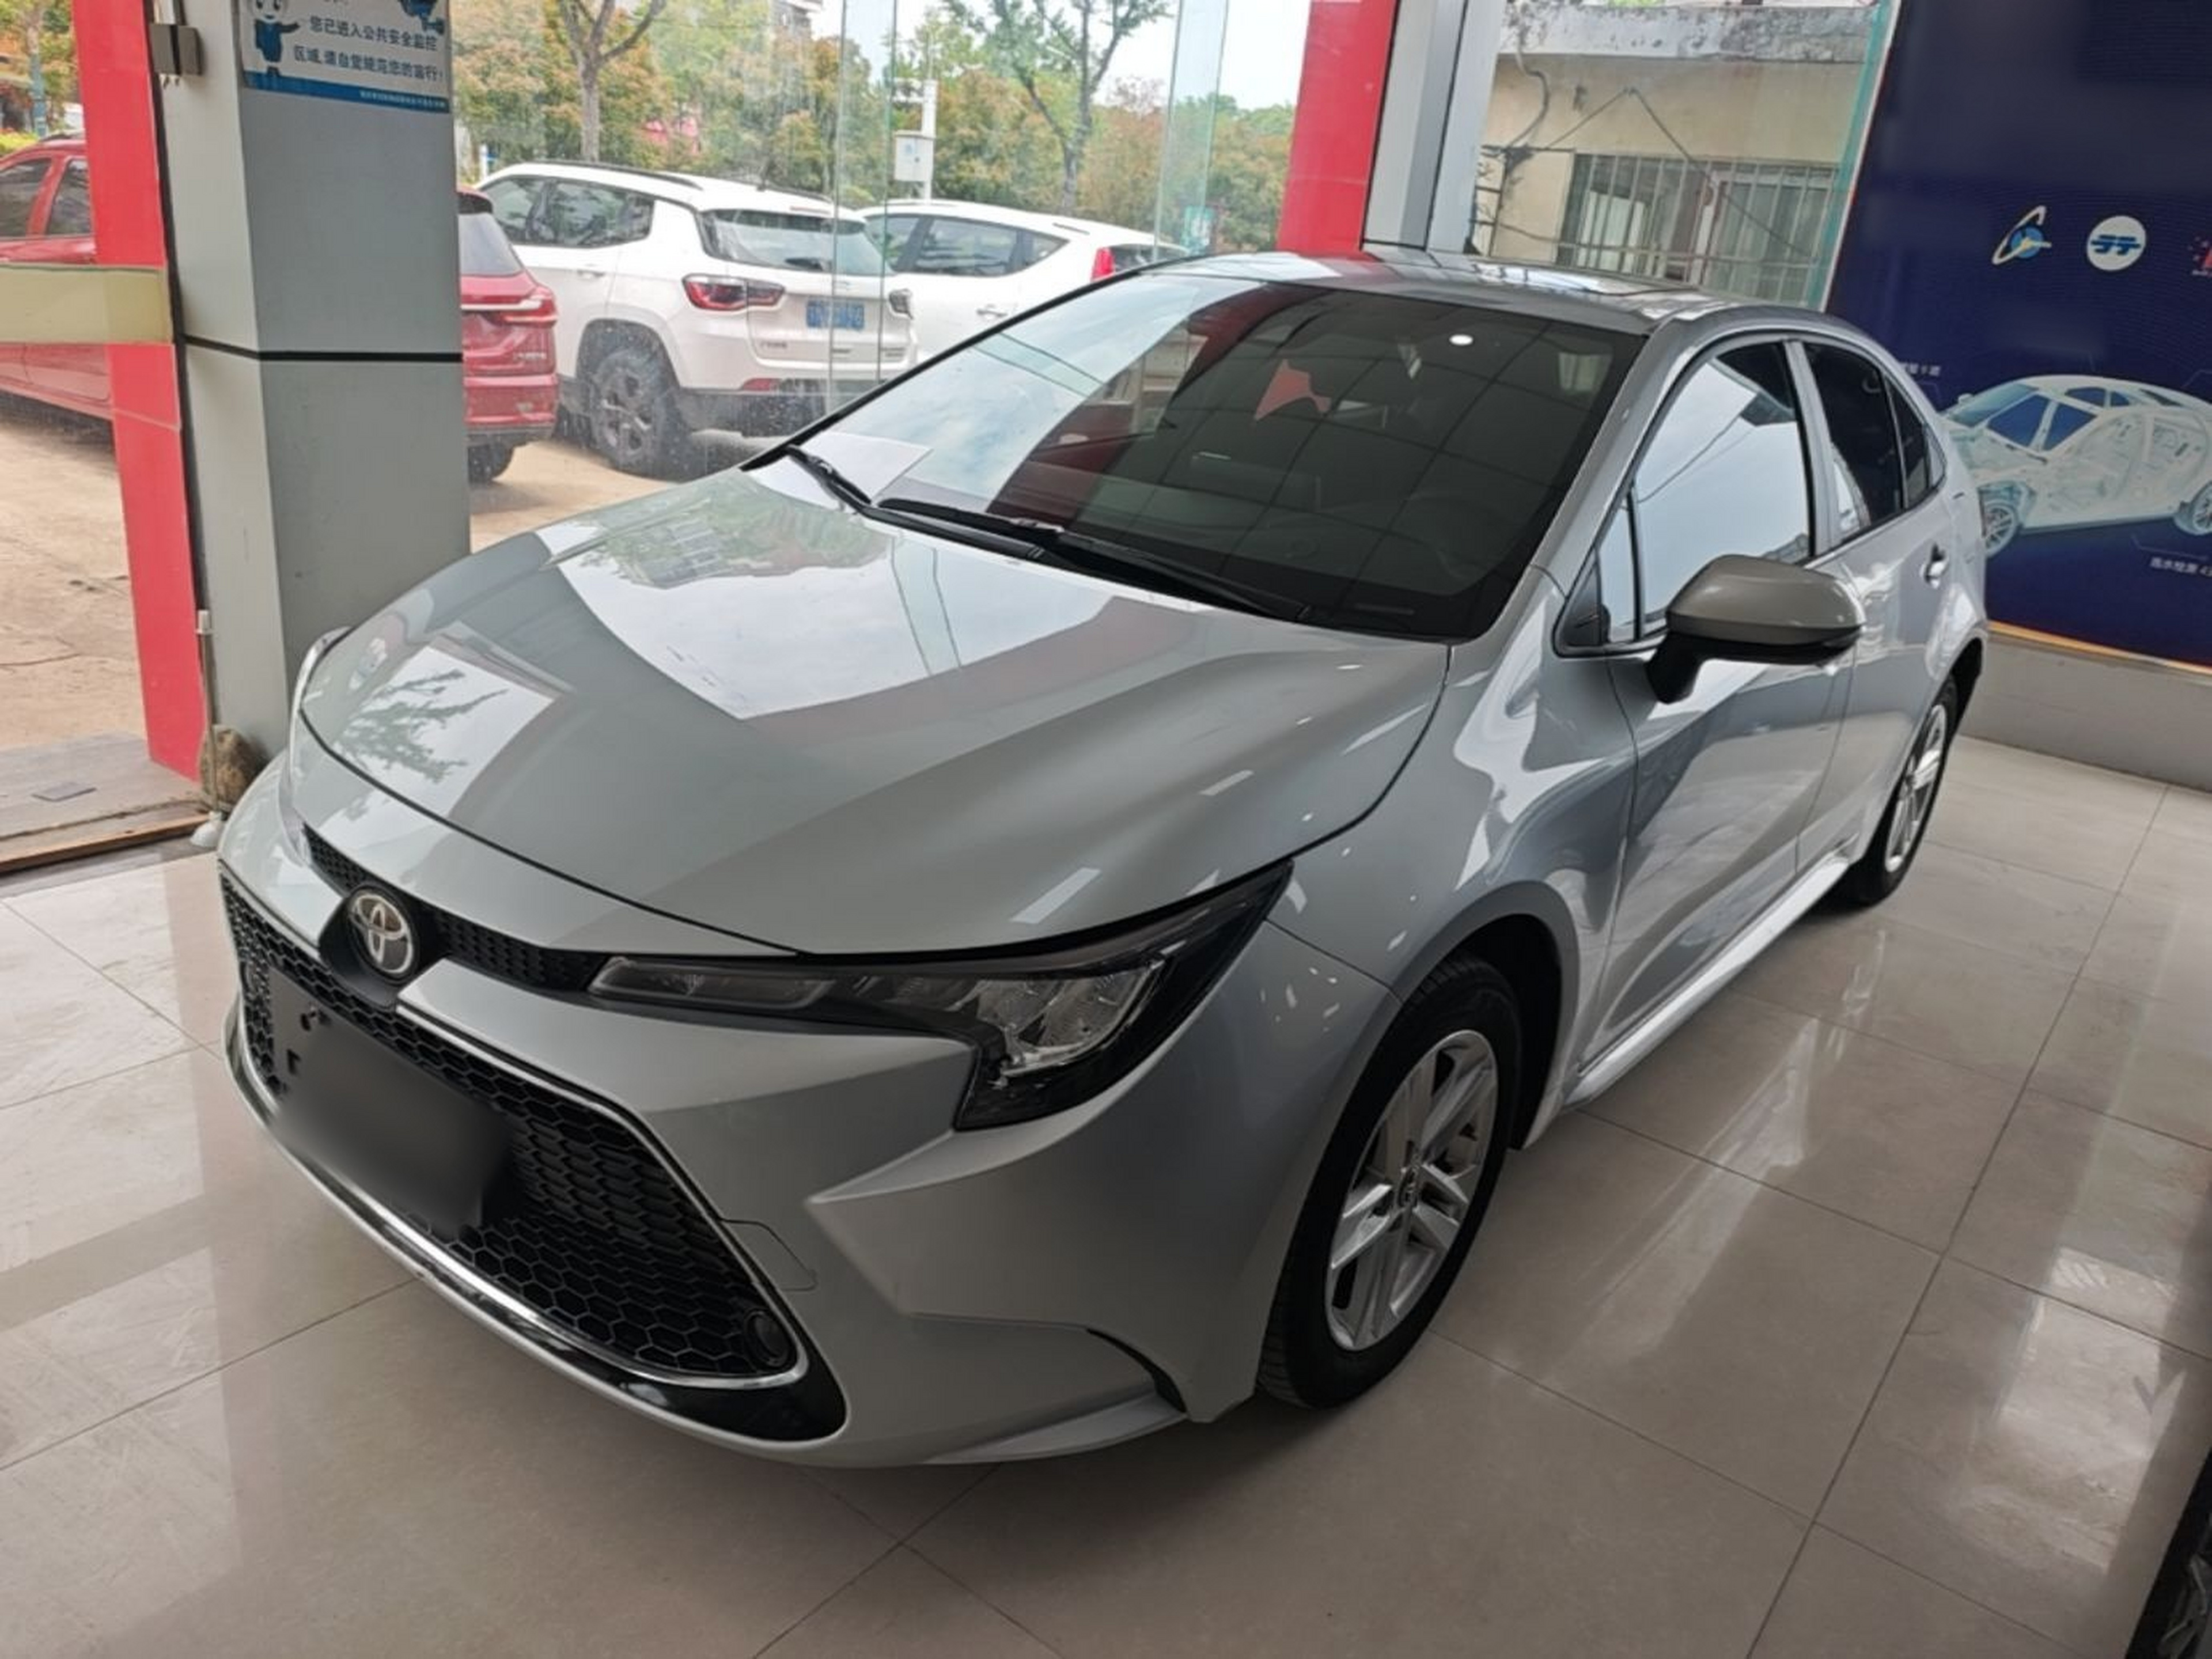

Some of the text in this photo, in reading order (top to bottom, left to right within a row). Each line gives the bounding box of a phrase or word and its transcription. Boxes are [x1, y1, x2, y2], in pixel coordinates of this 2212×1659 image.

[310, 16, 437, 51] 您已进入公共安全监控
